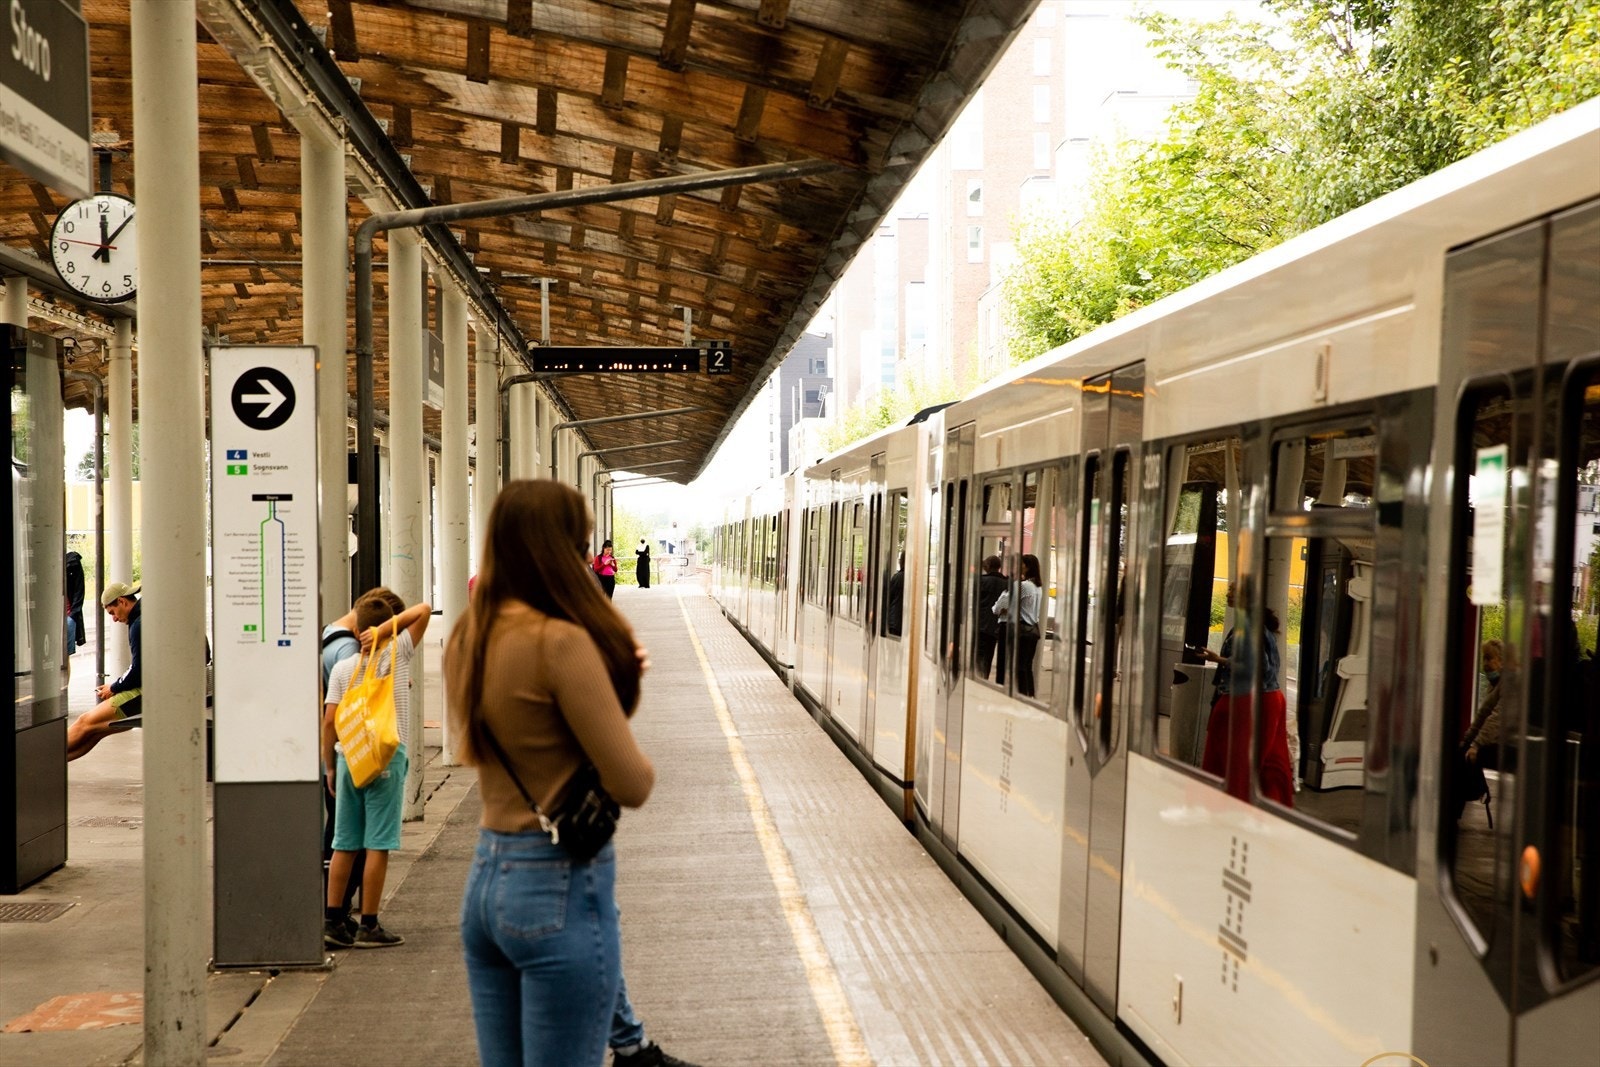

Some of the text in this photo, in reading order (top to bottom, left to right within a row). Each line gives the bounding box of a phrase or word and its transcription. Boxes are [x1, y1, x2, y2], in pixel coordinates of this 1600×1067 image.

[10, 0, 51, 83] Storo
[79, 206, 89, 219] 11
[97, 201, 110, 213] 12
[63, 221, 75, 234] 10
[60, 241, 70, 254] 9
[66, 261, 76, 274] 8
[81, 275, 91, 288] 7
[101, 280, 112, 293] 6
[123, 275, 132, 288] 5
[714, 351, 724, 366] 2
[234, 451, 240, 459] 4
[234, 466, 241, 474] 5
